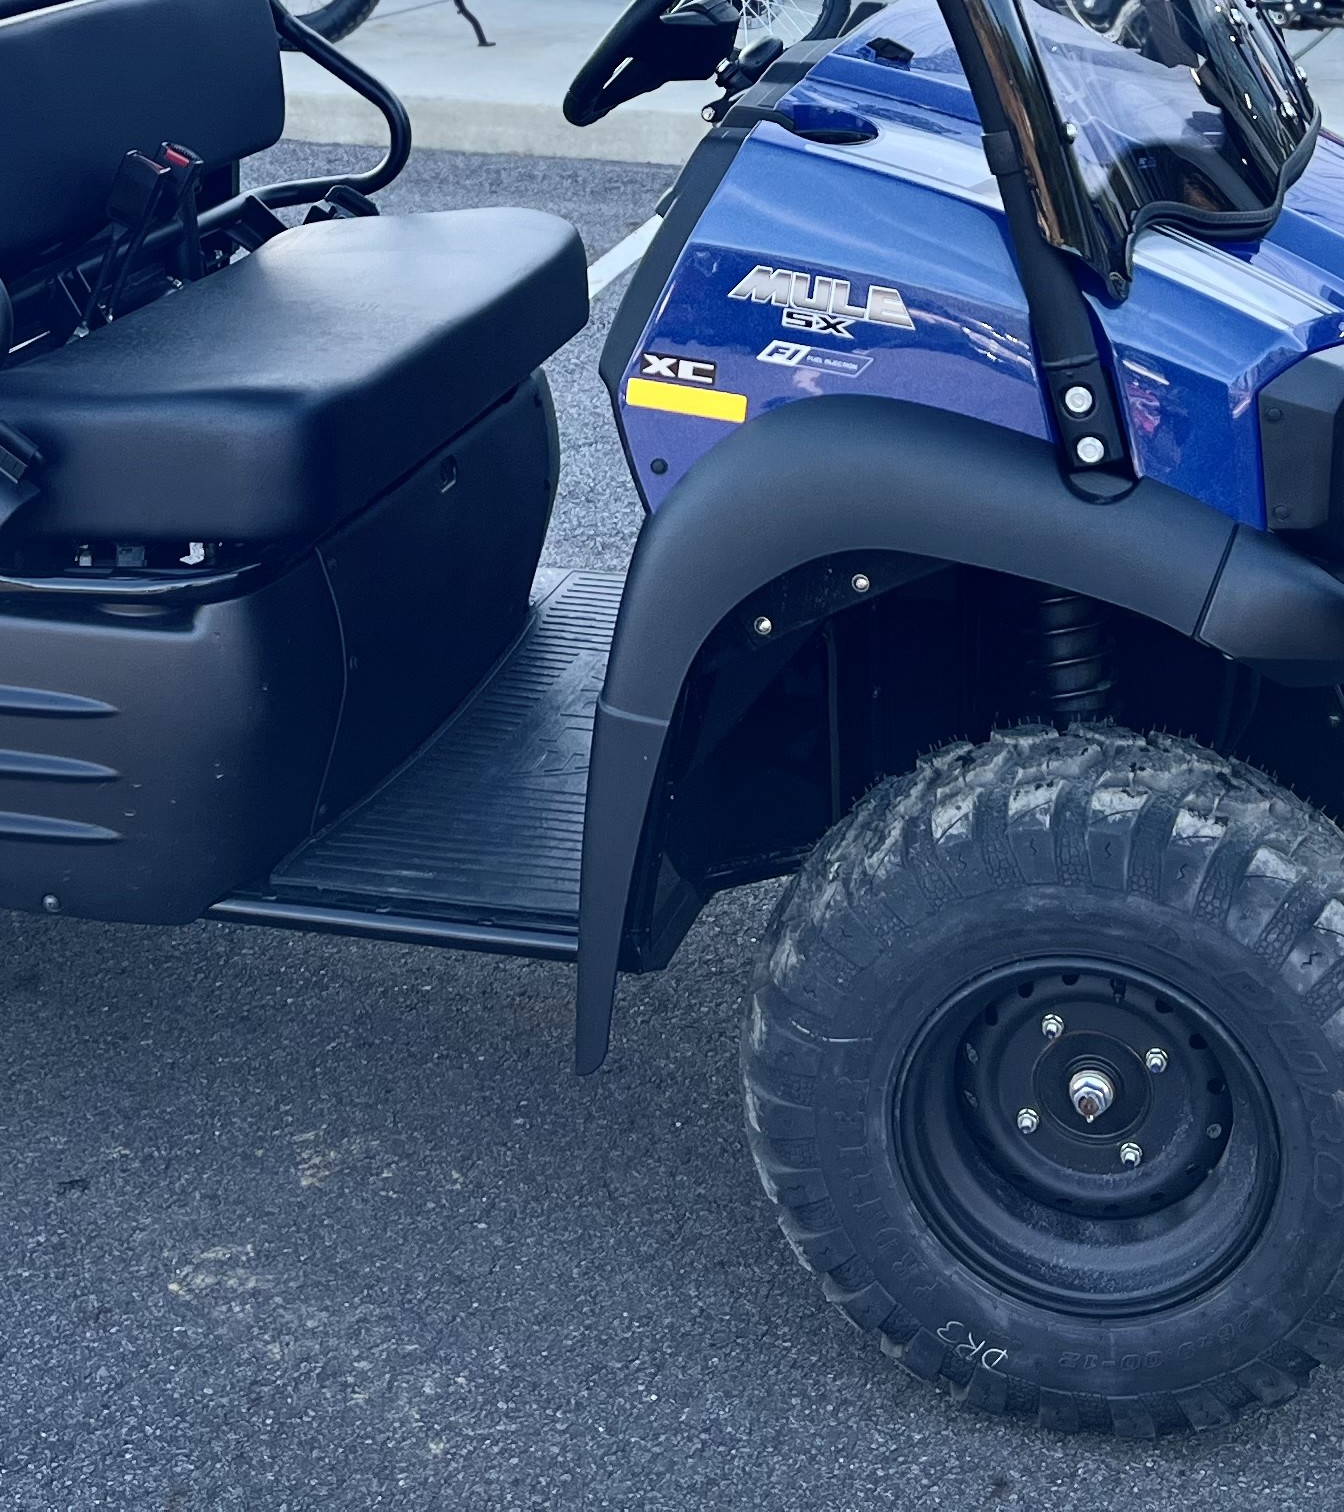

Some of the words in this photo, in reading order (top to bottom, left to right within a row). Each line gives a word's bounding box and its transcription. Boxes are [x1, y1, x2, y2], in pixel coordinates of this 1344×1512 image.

[727, 264, 917, 331] MULE
[781, 307, 857, 339] SX
[641, 353, 715, 384] XC
